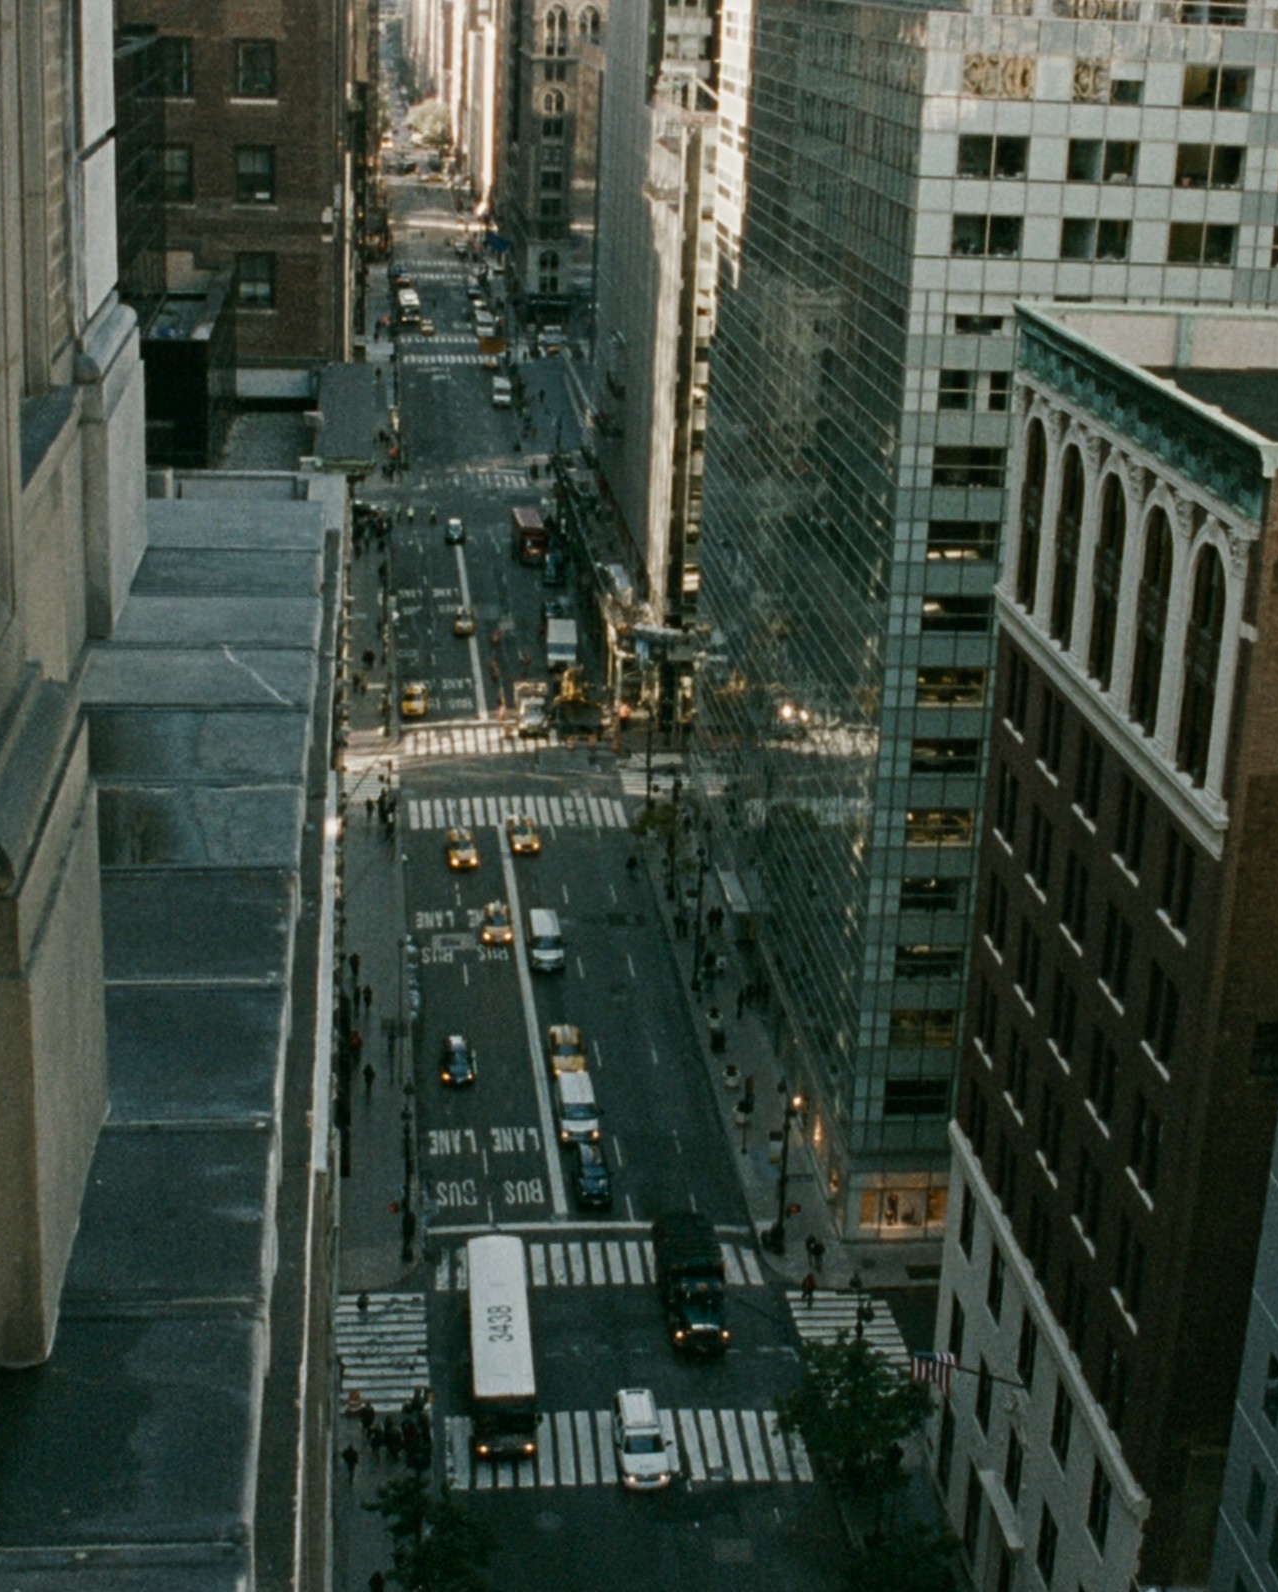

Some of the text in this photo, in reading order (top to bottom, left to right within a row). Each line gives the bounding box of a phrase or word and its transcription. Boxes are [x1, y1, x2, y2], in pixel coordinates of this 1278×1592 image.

[428, 1128, 477, 1155] LANE
[490, 1127, 540, 1152] LANE
[436, 1179, 478, 1207] BUS
[503, 1178, 545, 1205] BUS
[487, 1304, 514, 1344] 3438
